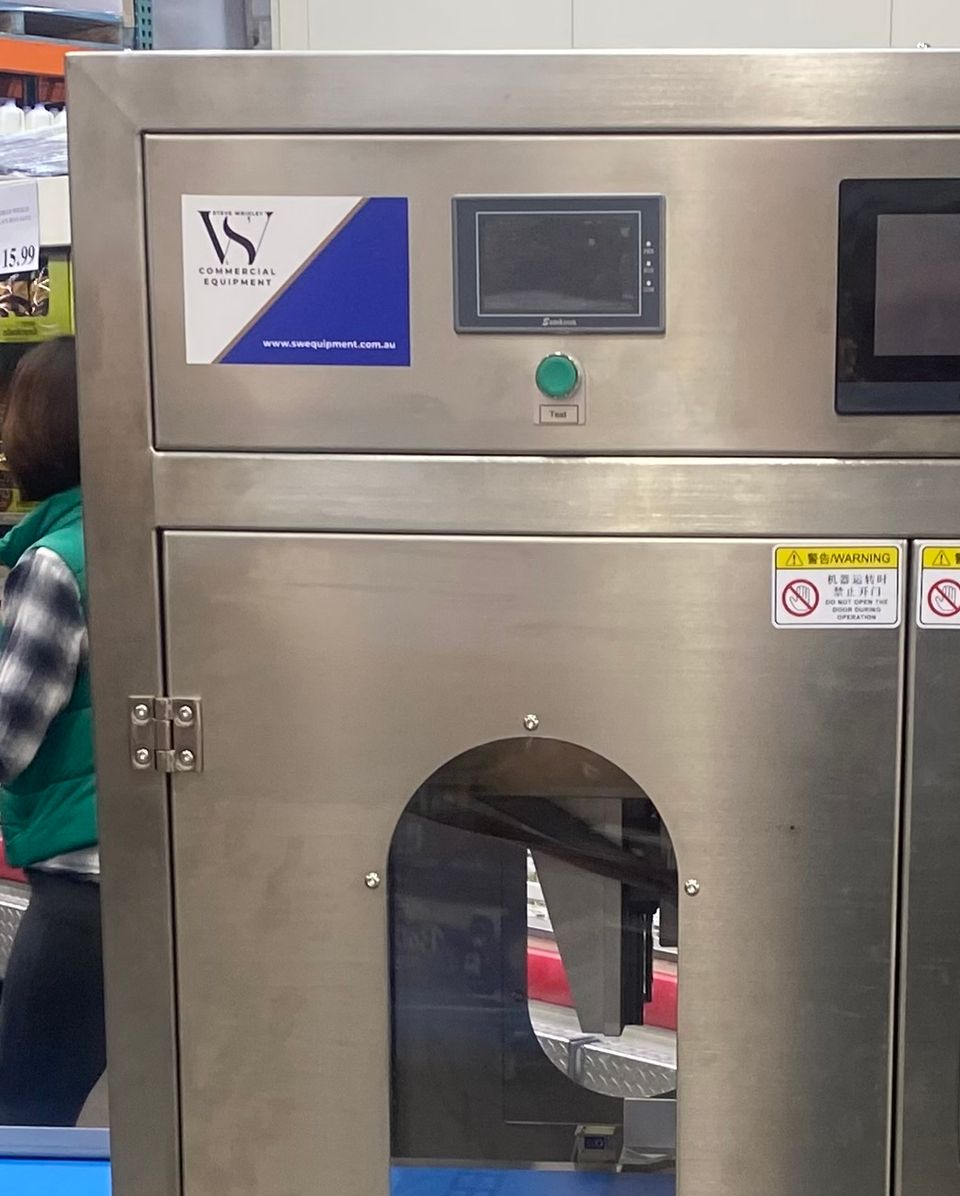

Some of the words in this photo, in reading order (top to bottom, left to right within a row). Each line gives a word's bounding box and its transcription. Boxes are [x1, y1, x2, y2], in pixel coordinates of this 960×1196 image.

[2, 244, 35, 269] 15.99
[198, 266, 277, 276] COMMERCIAL
[203, 277, 272, 287] EQUIPMENT
[262, 338, 397, 351] www.swequipment.com.au
[807, 552, 891, 564] 警告/WARNING
[827, 573, 887, 585] 机器运转时
[833, 586, 881, 597] 禁止开门
